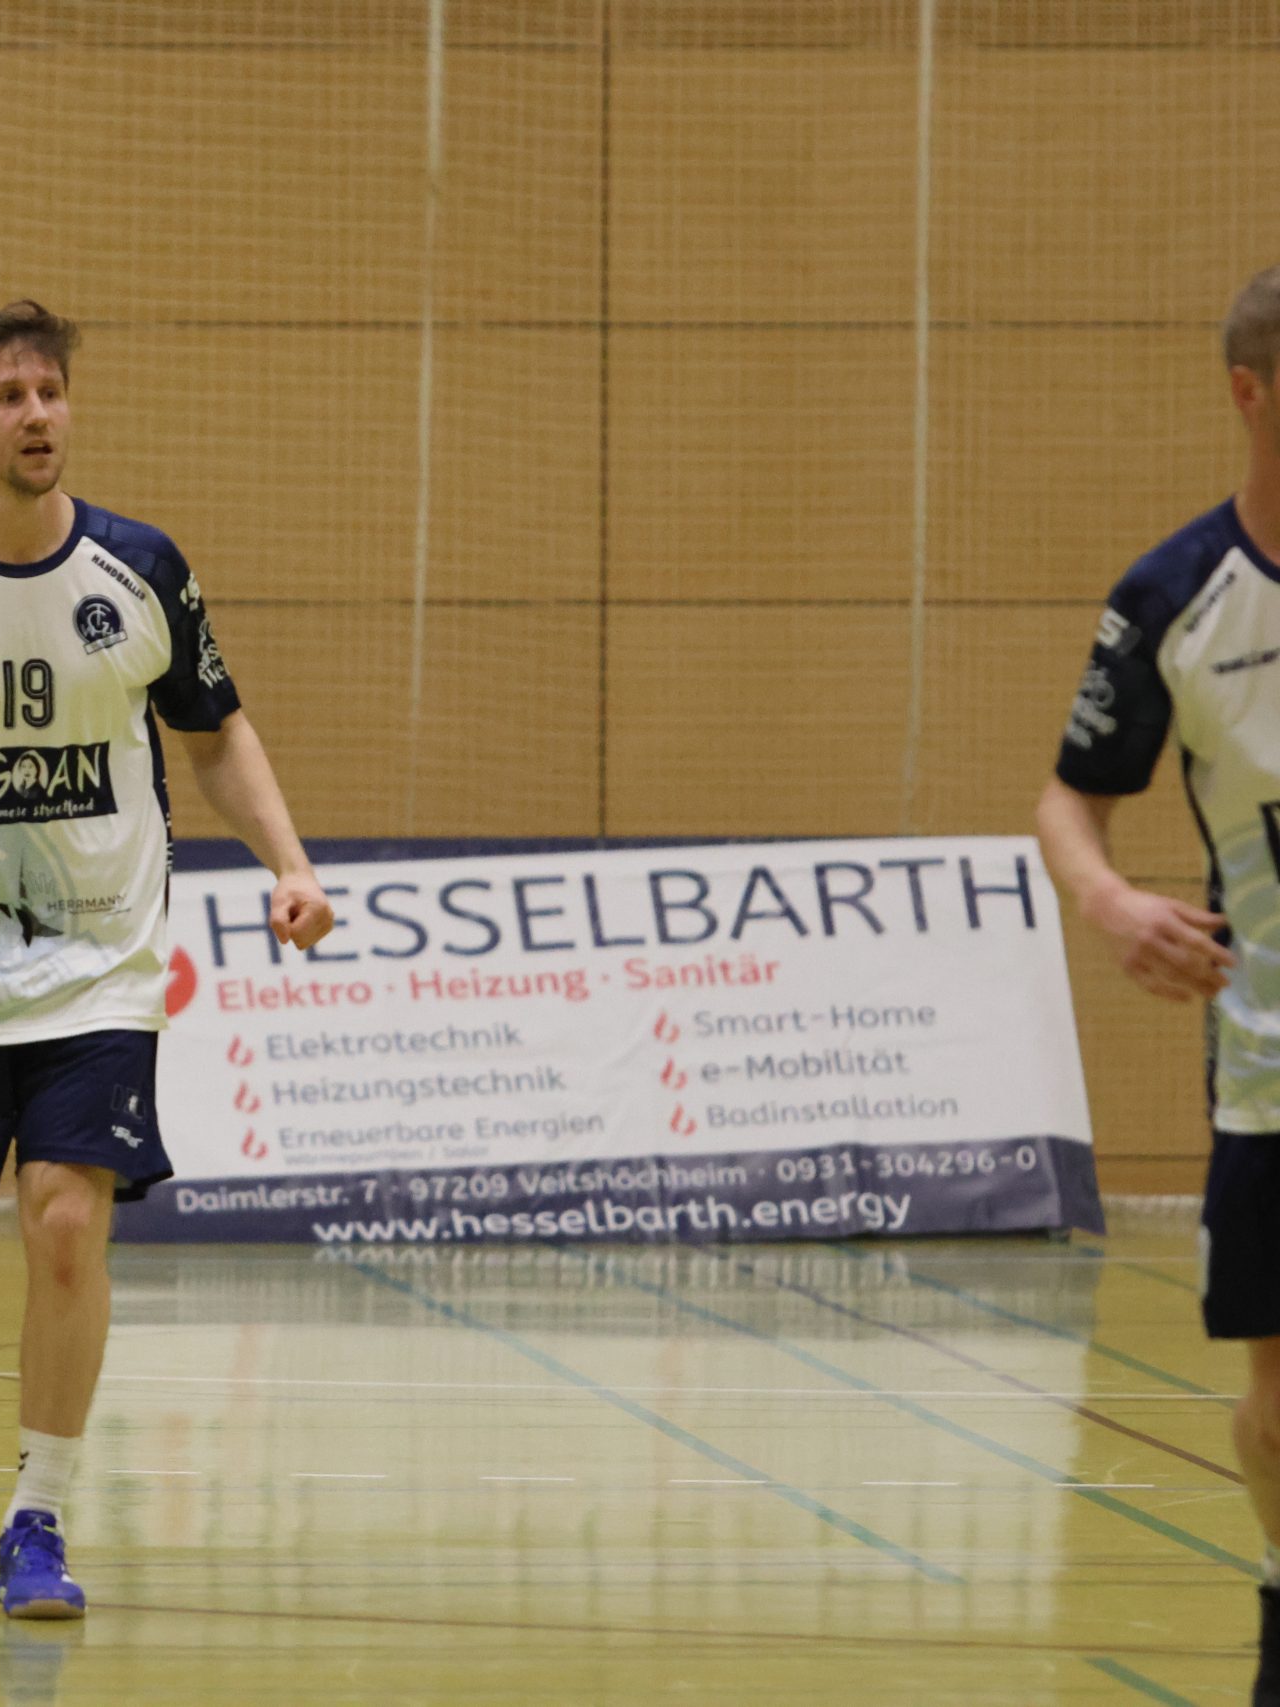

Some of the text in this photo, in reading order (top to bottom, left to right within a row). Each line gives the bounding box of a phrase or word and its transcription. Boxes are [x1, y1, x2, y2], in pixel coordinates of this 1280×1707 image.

[3, 658, 54, 729] 19
[204, 855, 1037, 967] HESSELBARTH
[216, 954, 780, 1013] Elektro Heizung Sanitär
[693, 1003, 937, 1038] Smart-Home
[266, 1022, 523, 1062] Elektrotechnik
[272, 1067, 567, 1105] Heizungstechnik
[701, 1049, 911, 1084] e-Mobilität
[278, 1112, 605, 1150] Erneuerbare Energien
[706, 1094, 959, 1129] Badinstallation
[176, 1145, 1037, 1214] Daimlerstr. 7 97209 Veitshöchheim 0931-304296-0
[313, 1190, 911, 1241] www.hesselbarth.energy
